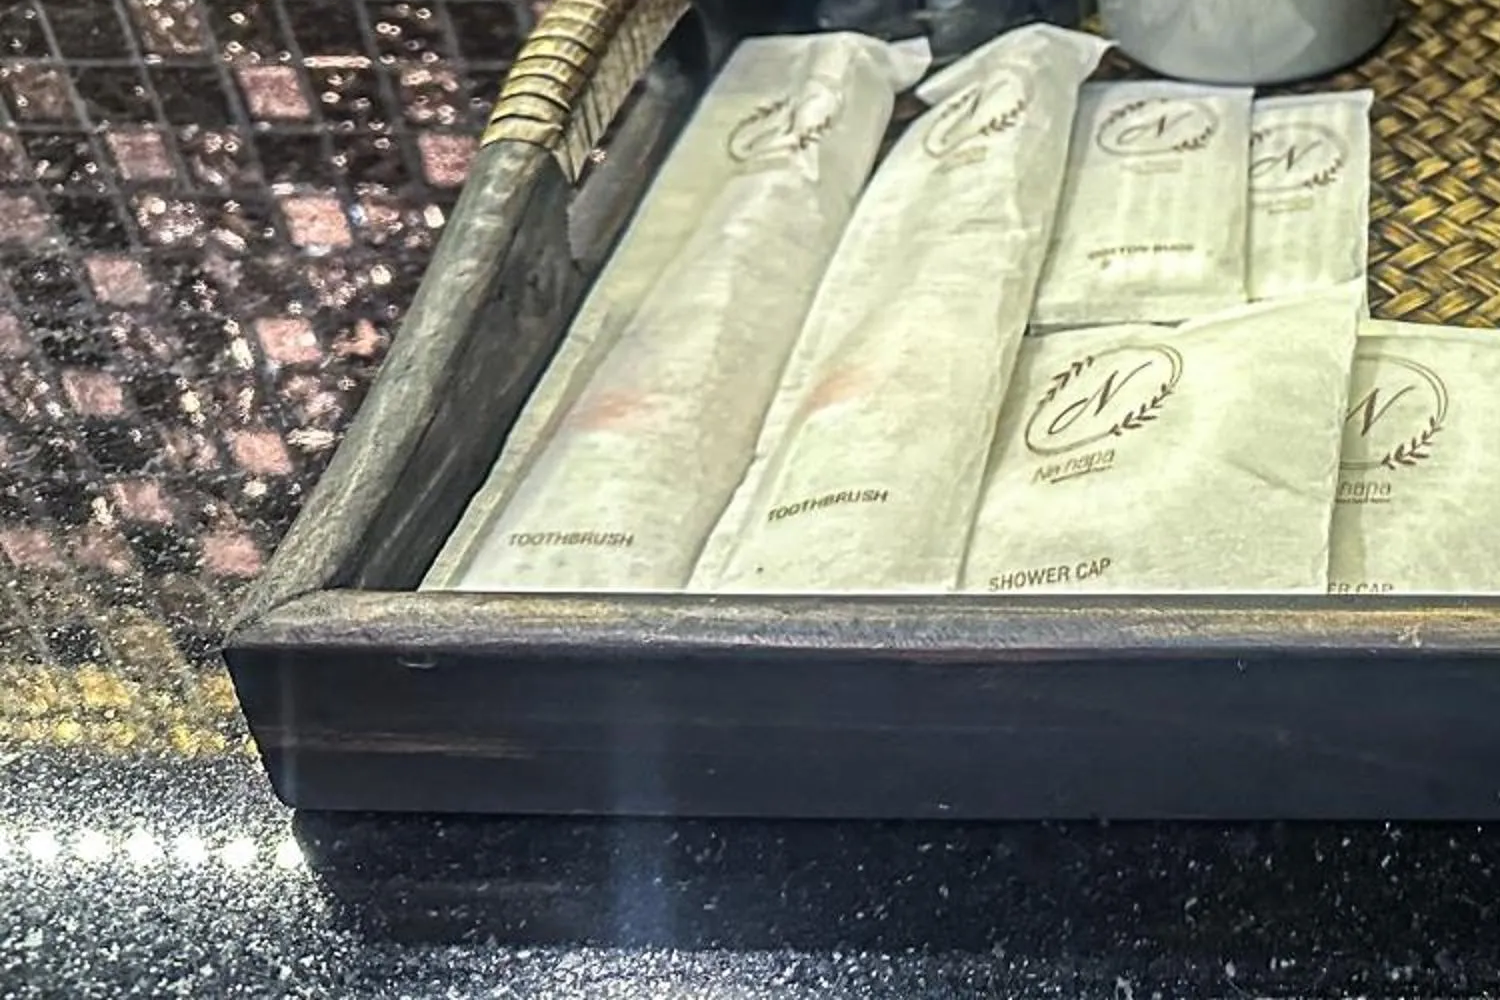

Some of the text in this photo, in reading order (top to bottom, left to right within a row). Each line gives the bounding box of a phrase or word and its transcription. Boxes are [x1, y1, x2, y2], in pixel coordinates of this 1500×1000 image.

[767, 488, 889, 523] TOOTHBRUSH
[507, 531, 634, 549] TOOTHBRUSH
[987, 557, 1111, 592] SHOWER CAP
